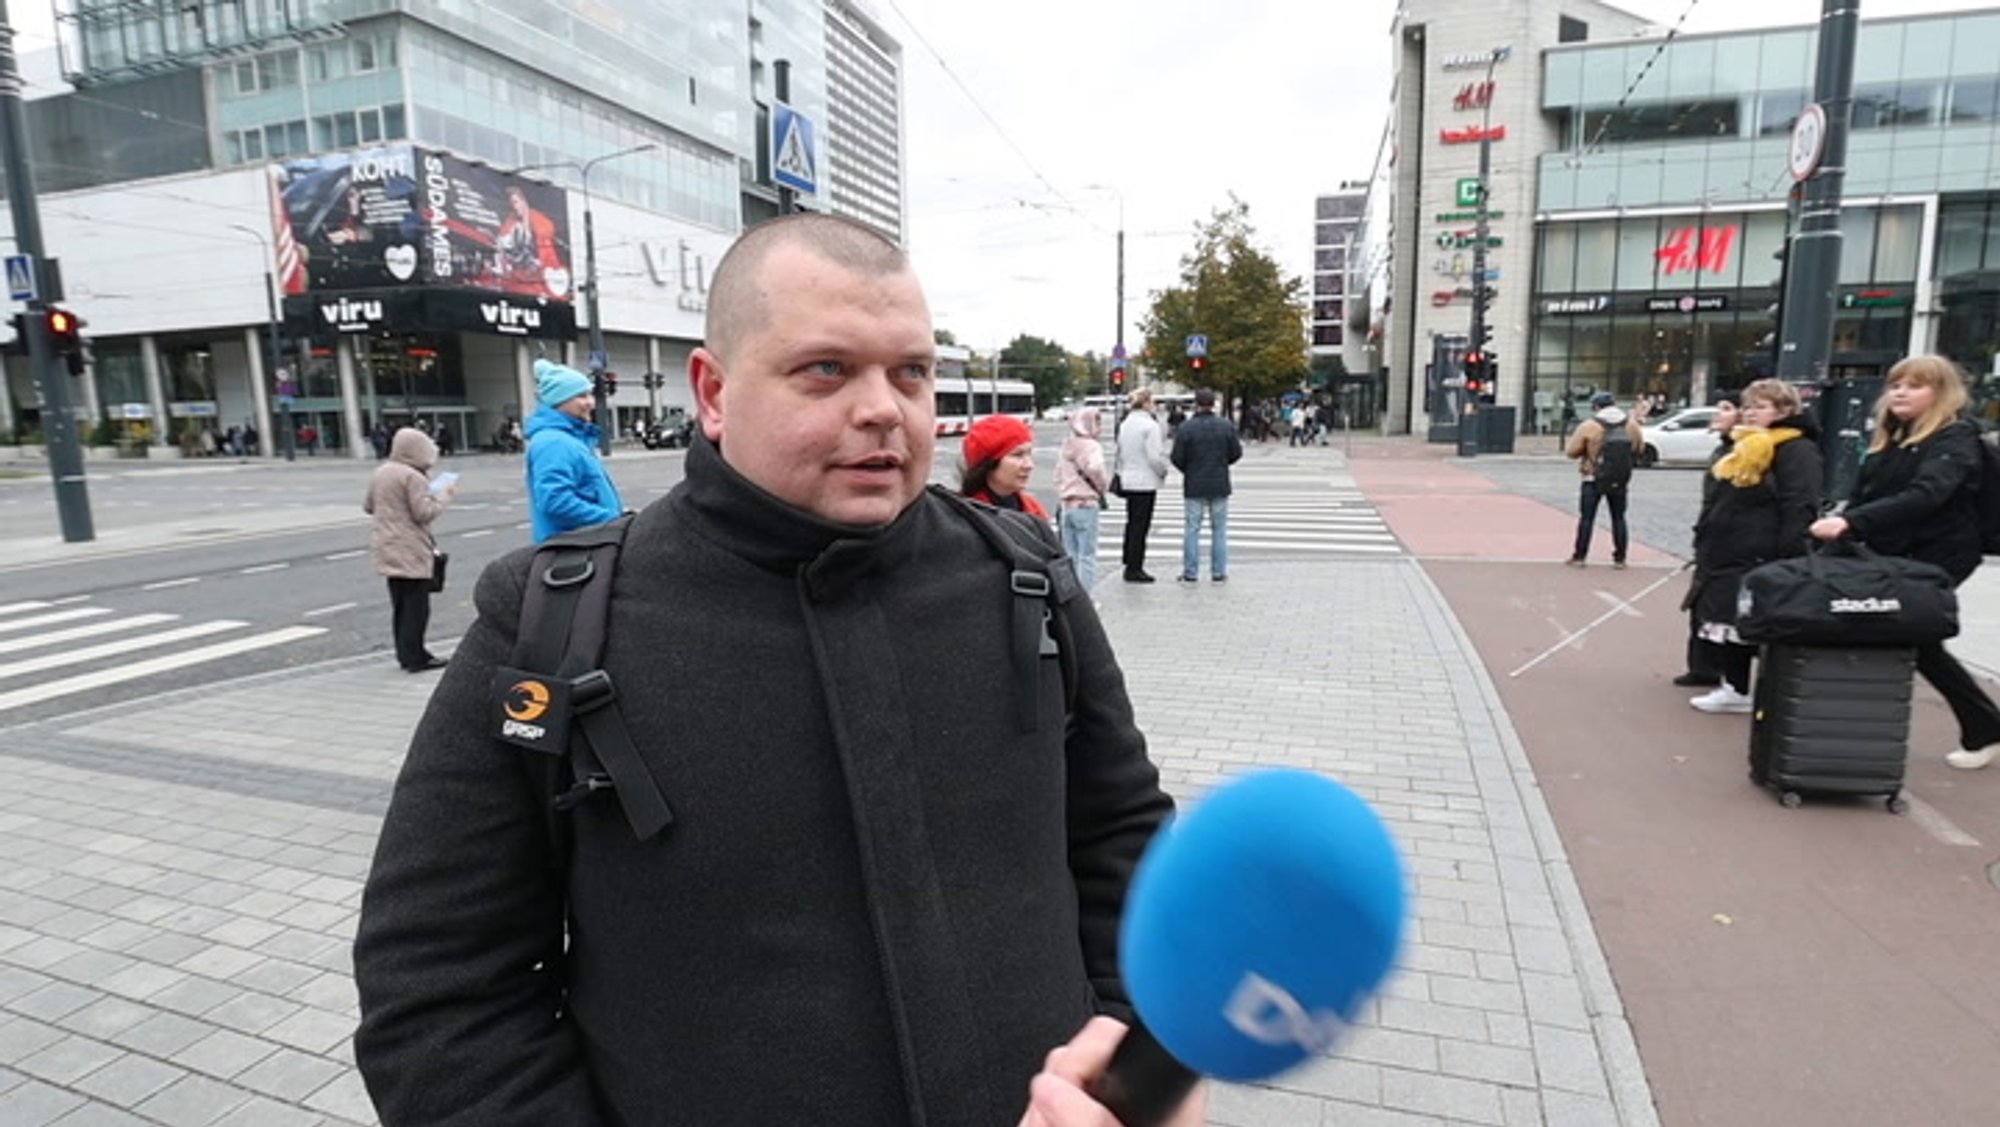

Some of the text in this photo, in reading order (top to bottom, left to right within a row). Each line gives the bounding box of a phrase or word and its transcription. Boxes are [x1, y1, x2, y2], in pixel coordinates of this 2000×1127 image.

[1655, 224, 1739, 275] H&M
[321, 297, 382, 323] viru
[480, 300, 540, 327] viru
